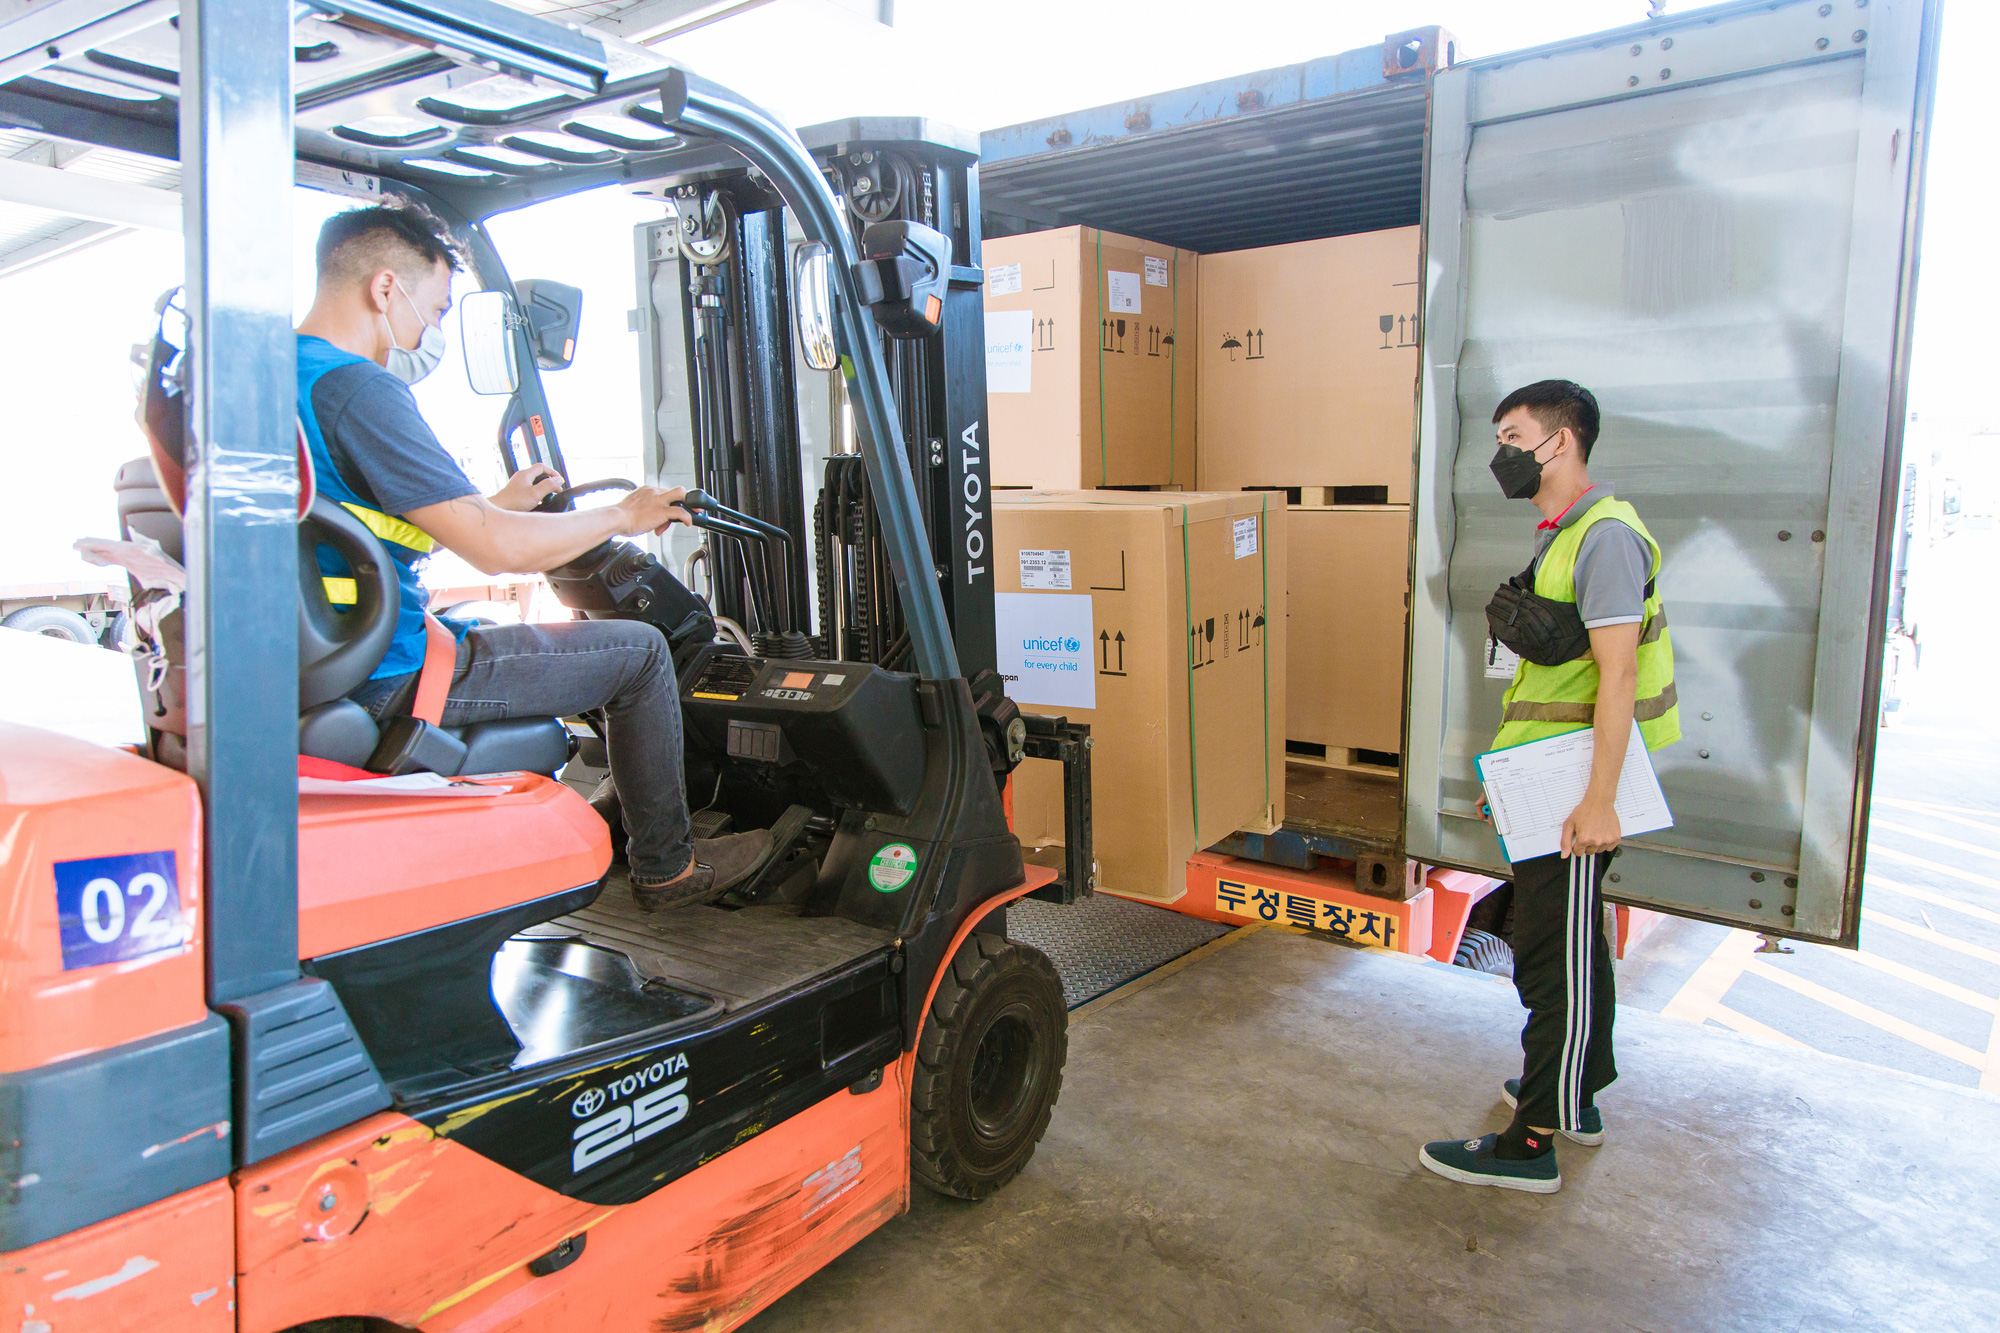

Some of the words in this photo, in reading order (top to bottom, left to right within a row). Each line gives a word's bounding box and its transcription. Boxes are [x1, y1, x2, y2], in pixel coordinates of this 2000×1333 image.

[987, 342, 1013, 354] unicef
[961, 420, 985, 585] TOYOTA
[1023, 636, 1063, 652] unicef
[1024, 659, 1035, 669] for
[1036, 662, 1058, 672] every
[1059, 661, 1078, 671] child
[1000, 673, 1019, 683] apan
[81, 872, 169, 943] 02
[1218, 880, 1396, 948] 두성특장차
[607, 1052, 689, 1101] TOYOTA
[573, 1076, 690, 1173] 25
